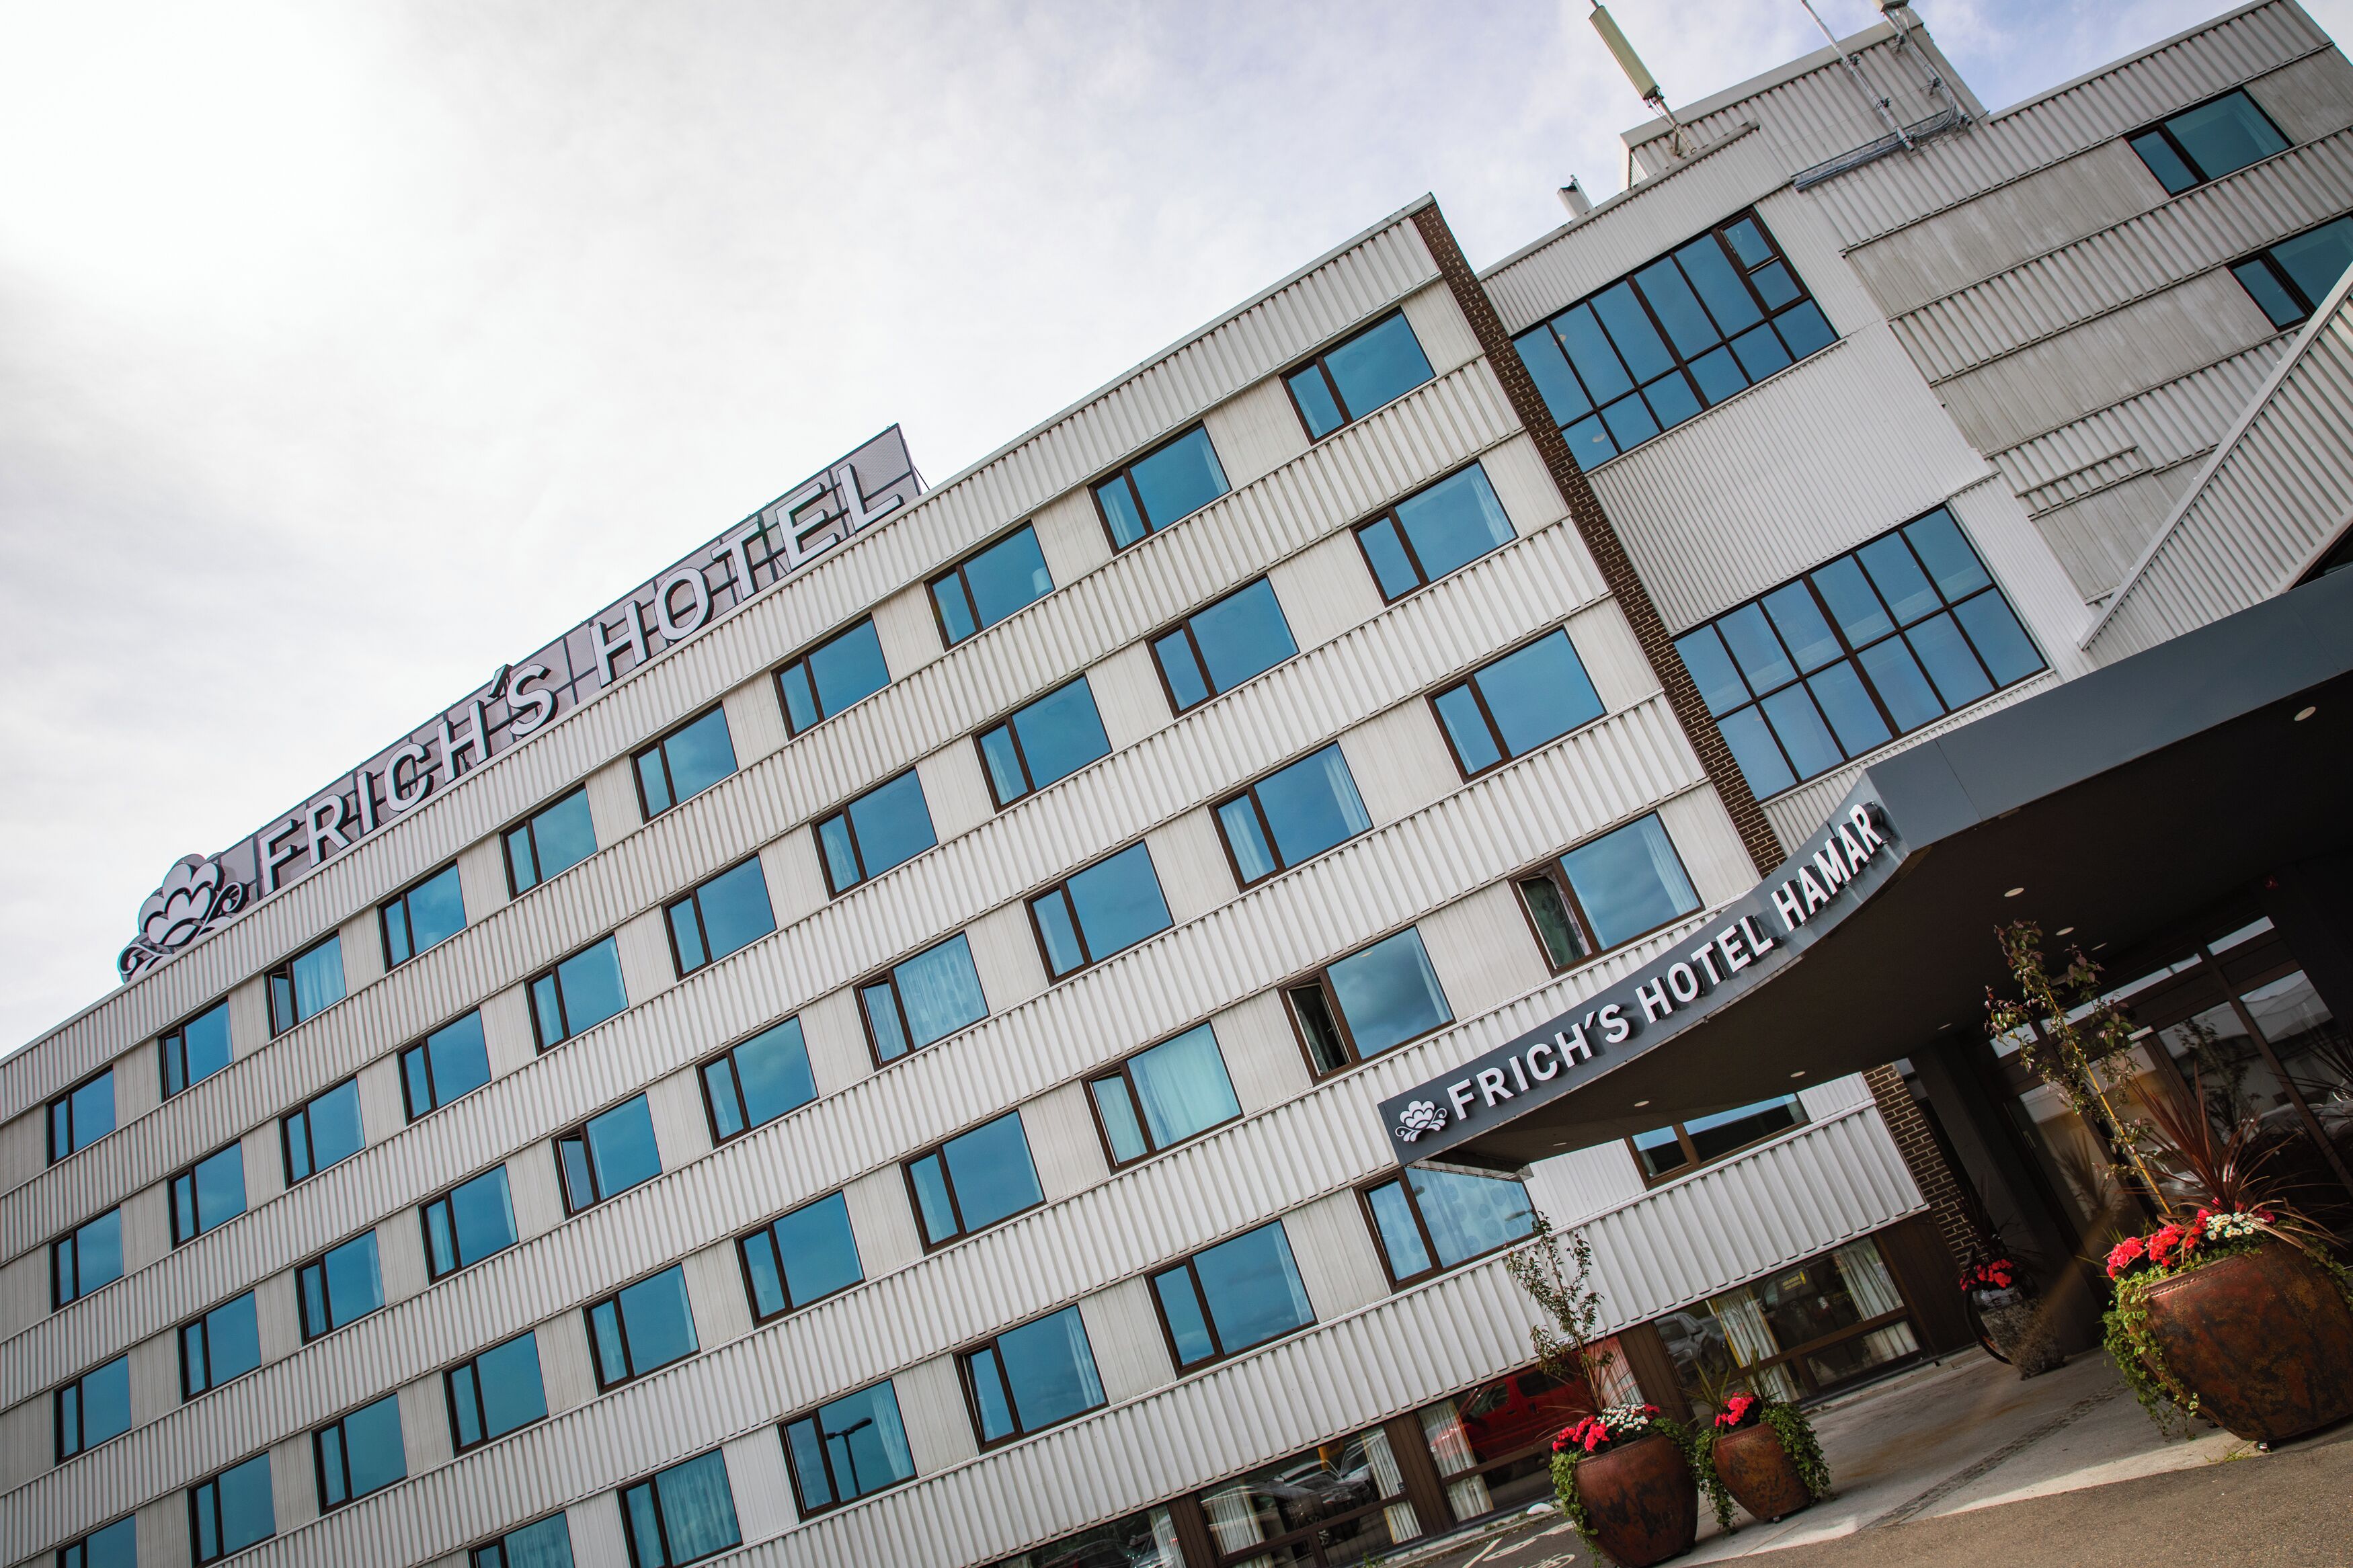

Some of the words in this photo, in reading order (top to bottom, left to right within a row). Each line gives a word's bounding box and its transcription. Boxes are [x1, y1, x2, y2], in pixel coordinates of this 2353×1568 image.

[589, 464, 903, 688] HOTEL
[1635, 916, 1774, 1024] HOTEL
[1770, 804, 1883, 932] HAMAR
